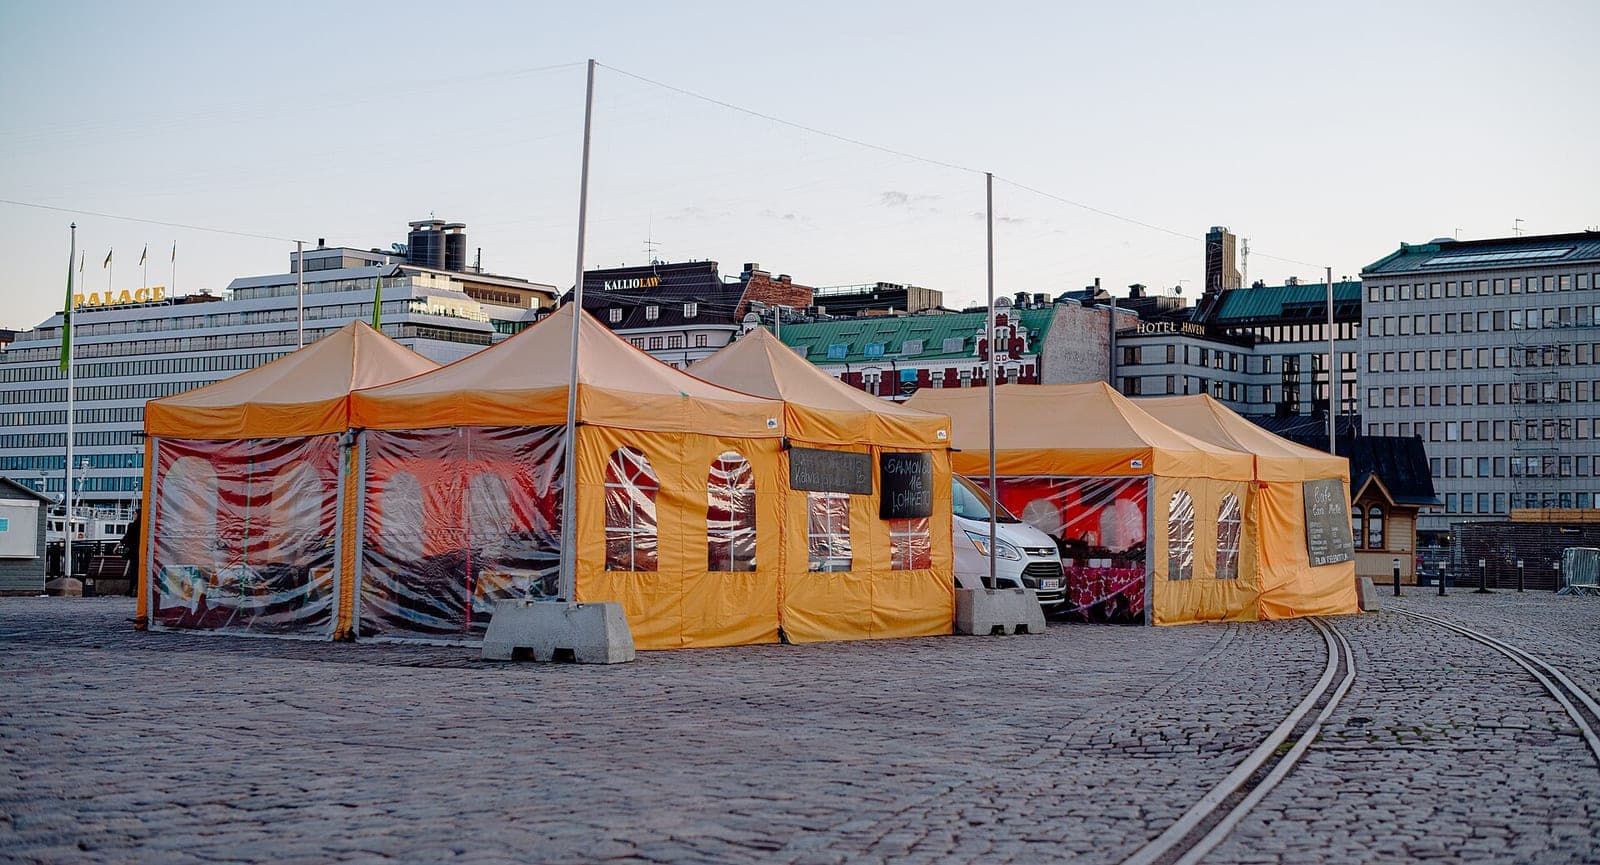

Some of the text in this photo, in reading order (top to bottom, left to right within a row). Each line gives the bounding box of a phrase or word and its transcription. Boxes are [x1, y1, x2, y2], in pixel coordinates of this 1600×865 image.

[604, 277, 659, 291] KALLIOLAW
[73, 286, 165, 309] PALACE
[1136, 321, 1206, 336] HOTEL HAVEN
